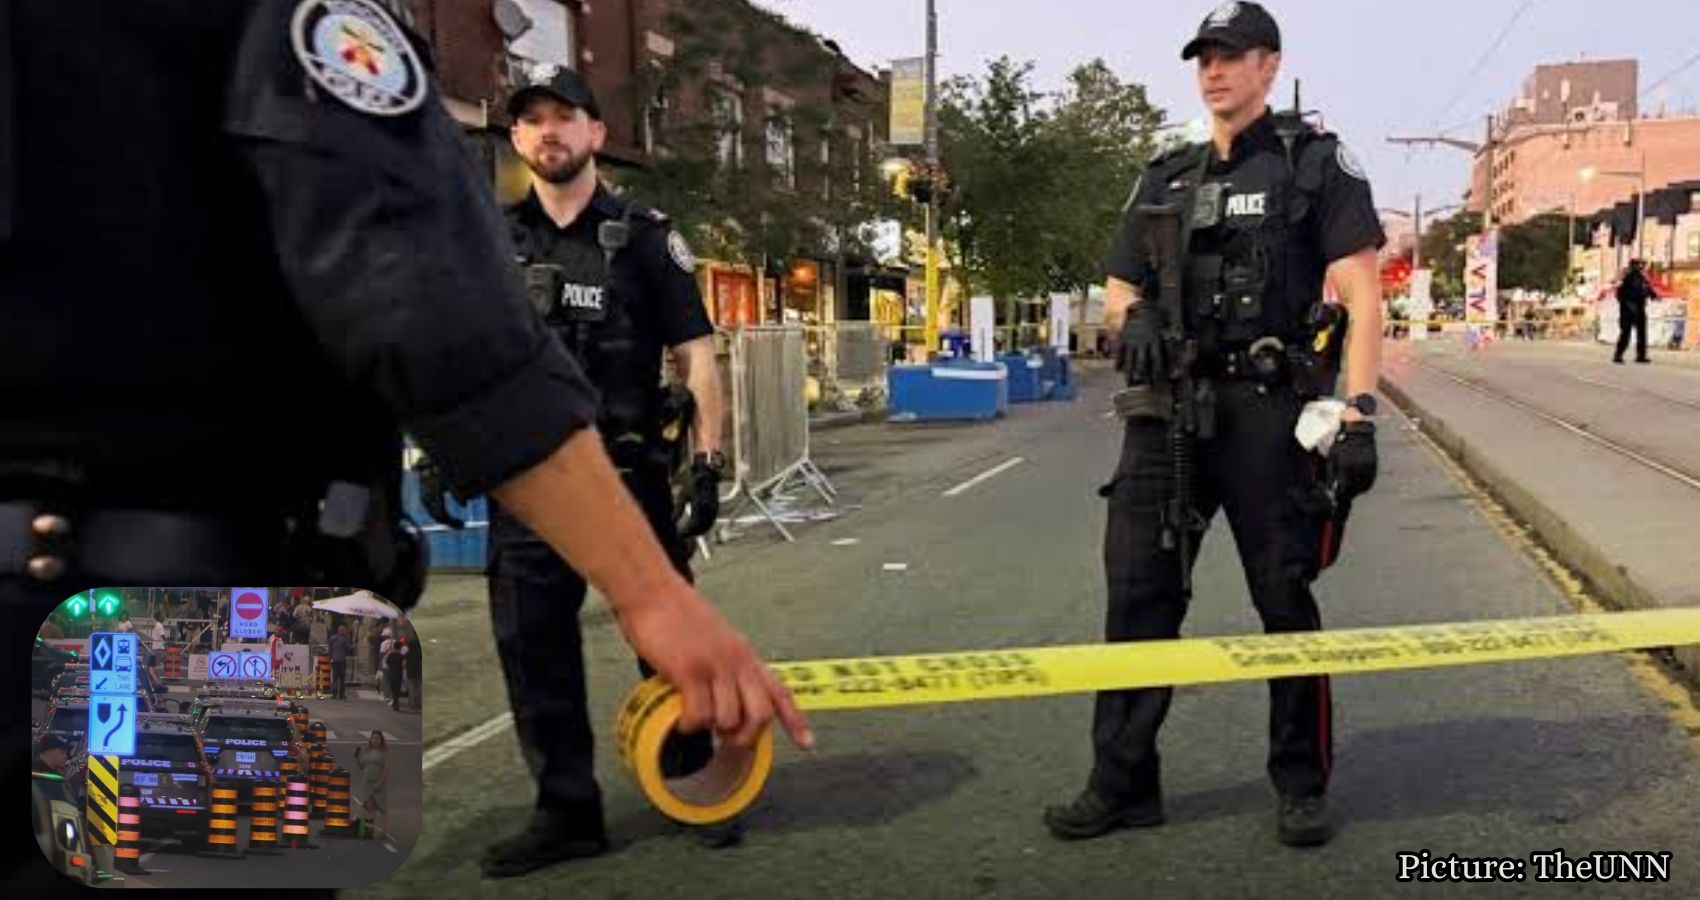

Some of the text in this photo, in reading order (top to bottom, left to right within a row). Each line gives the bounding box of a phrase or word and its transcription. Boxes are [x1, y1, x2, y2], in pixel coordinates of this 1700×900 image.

[1225, 193, 1265, 217] POLICE
[561, 282, 604, 310] POLICE
[225, 738, 267, 746] POLICE
[121, 759, 171, 768] POLICE
